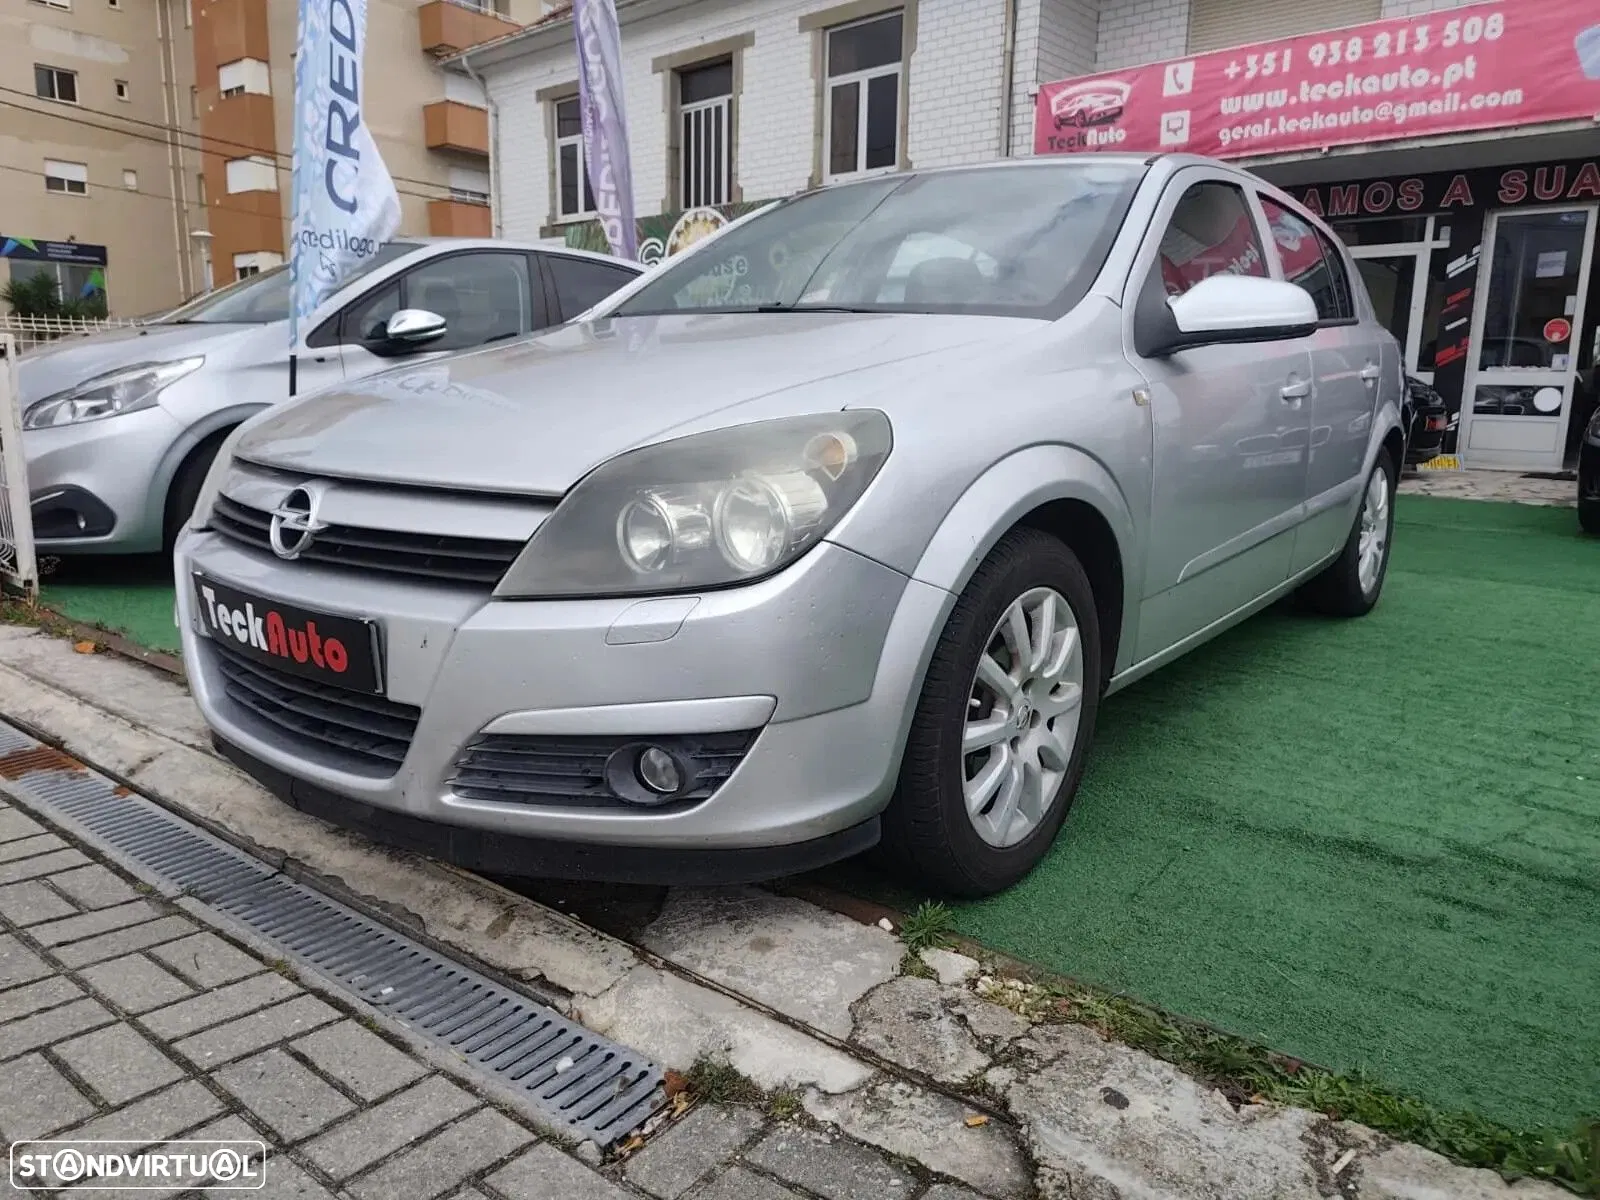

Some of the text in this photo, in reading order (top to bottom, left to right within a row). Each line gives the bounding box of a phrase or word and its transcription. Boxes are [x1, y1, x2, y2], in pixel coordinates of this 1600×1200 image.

[1224, 12, 1505, 80] +351 938 213 508
[1219, 54, 1478, 116] www.teckauto.pt
[1218, 87, 1524, 146] geral.teckauto@gmail.com
[1297, 162, 1600, 218] AMOS A SUA
[201, 584, 349, 674] TeckAuto
